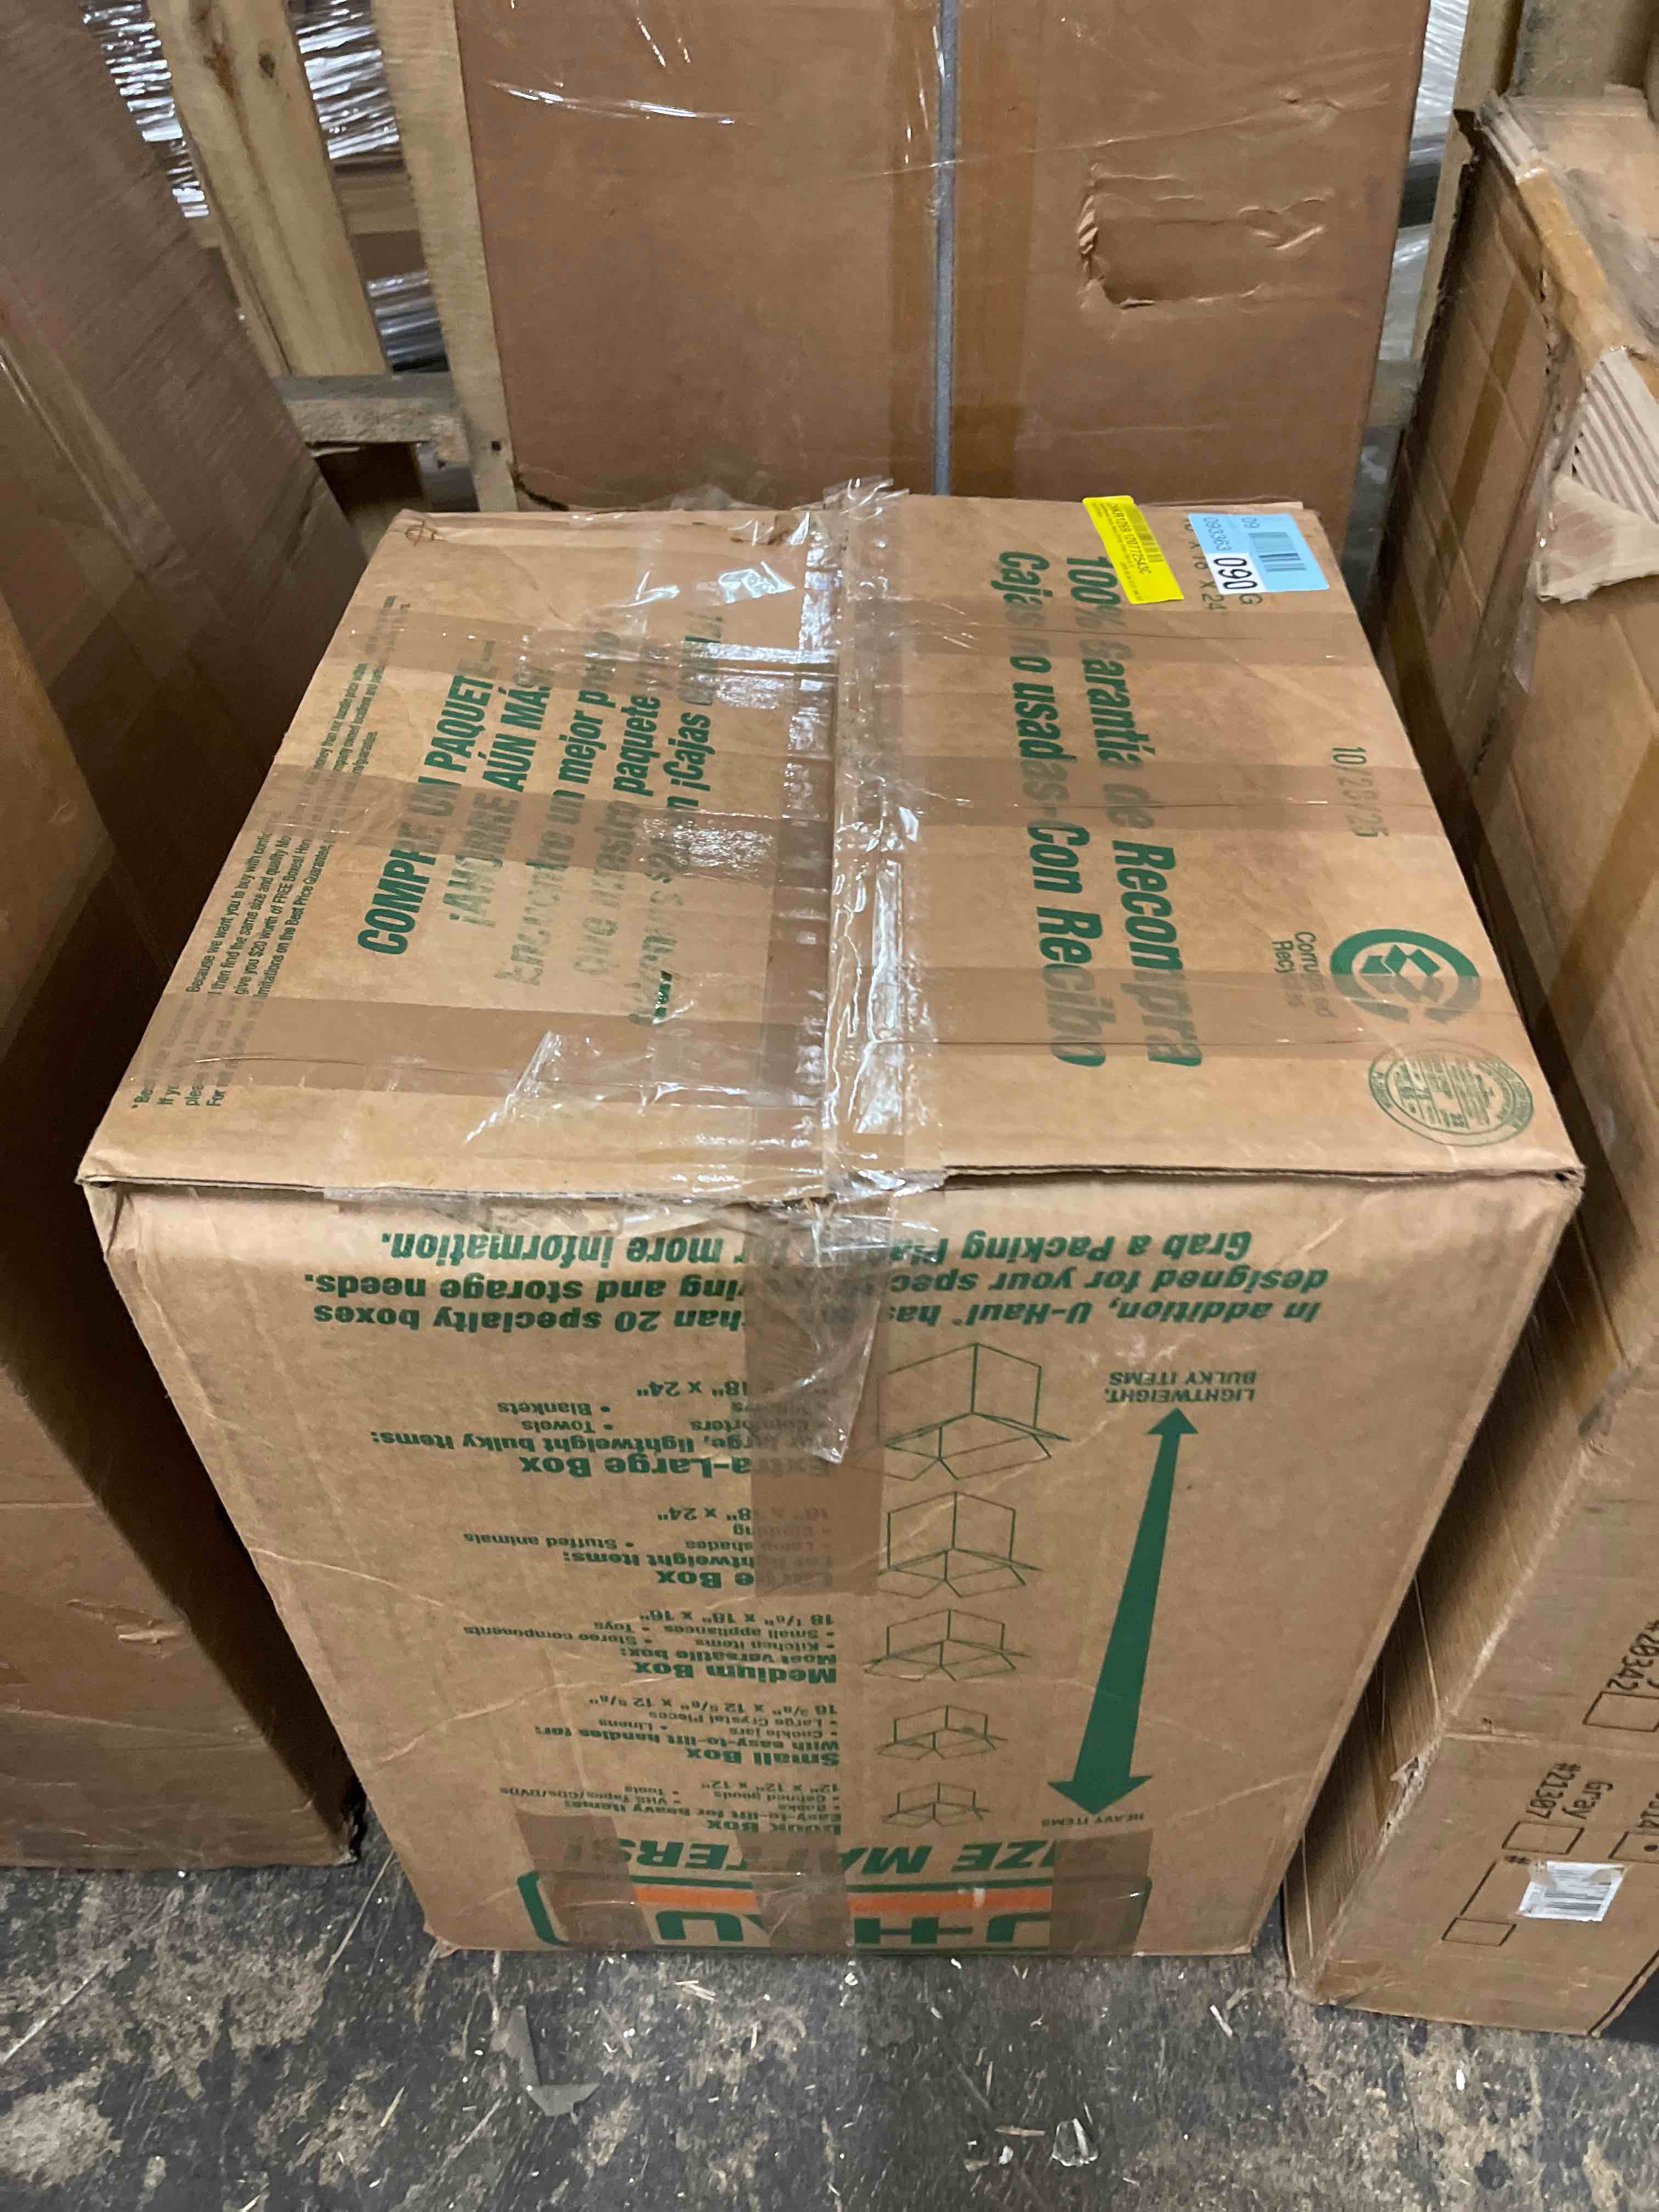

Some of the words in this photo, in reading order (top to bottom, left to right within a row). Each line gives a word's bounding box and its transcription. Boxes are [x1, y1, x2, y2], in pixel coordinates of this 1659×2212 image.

[1214, 557, 1257, 589] 090
[1202, 594, 1227, 610] 24
[557, 710, 606, 784] mejor
[613, 694, 661, 797] paquete
[478, 733, 537, 792] AÚN
[547, 790, 585, 826] un
[991, 552, 1053, 624] Cajas
[1036, 906, 1116, 1066] Recibo
[245, 856, 262, 872] with
[266, 849, 288, 875] quality
[357, 820, 447, 954] COMPRE
[403, 776, 461, 816] UN
[236, 873, 255, 889] buy
[257, 877, 273, 892] and
[250, 894, 266, 910] size
[273, 884, 293, 904] FREE
[294, 886, 313, 905] Price
[225, 900, 240, 915] you
[270, 905, 282, 914] of
[239, 911, 258, 935] same
[285, 907, 303, 926] Best
[213, 917, 233, 938] want
[258, 916, 278, 939] worth
[279, 927, 296, 940] the
[207, 941, 222, 953] we
[229, 937, 247, 950] the
[249, 941, 267, 957] $20
[276, 943, 289, 952] on
[217, 952, 239, 968] find
[1112, 840, 1203, 1066] Recompra
[186, 956, 215, 992] Because
[244, 960, 257, 975] you
[210, 970, 230, 989] then
[234, 977, 249, 995] give
[381, 1232, 614, 1269] information.
[628, 1236, 724, 1267] more
[961, 1231, 1114, 1264] Packing
[1130, 1234, 1153, 1259] a
[1167, 1230, 1253, 1264] Grab
[304, 1273, 427, 1299] needs.
[987, 1267, 1075, 1293] your
[1085, 1269, 1142, 1293] for
[1153, 1264, 1329, 1293] designed
[440, 1272, 583, 1304] storage
[596, 1278, 667, 1304] and
[314, 1304, 420, 1330] boxes
[1109, 1296, 1274, 1324] addition,
[1283, 1300, 1322, 1324] In
[434, 1306, 602, 1331] specialty
[616, 1310, 662, 1333] 20
[1109, 1372, 1177, 1385] ITEMS
[1185, 1371, 1256, 1385] BULKY
[636, 1380, 680, 1396] 24"
[686, 1380, 702, 1395] x
[497, 1402, 592, 1415] Blankets
[521, 1419, 593, 1433] Towels
[462, 1433, 534, 1452] bulky
[541, 1435, 695, 1454] lightweight
[518, 1455, 592, 1478] Box
[657, 1507, 697, 1521] 24"
[703, 1507, 716, 1517] x
[463, 1533, 539, 1547] animals
[546, 1537, 617, 1549] Stuffed
[655, 1570, 723, 1588] Box
[463, 1626, 574, 1641] components
[593, 1622, 633, 1633] Toys
[663, 1623, 761, 1637] appliances
[766, 1628, 819, 1639] Small
[578, 1633, 637, 1646] Stereo
[746, 1640, 819, 1652] Kitchen
[619, 1647, 669, 1660] box:
[675, 1649, 774, 1663] versatile
[778, 1652, 837, 1664] Most
[633, 1661, 695, 1679] Box
[706, 1664, 837, 1684] Medium
[598, 1718, 653, 1730] Linens
[709, 1713, 769, 1727] Crystal
[775, 1717, 822, 1728] Large
[578, 1728, 660, 1743] handles
[666, 1734, 784, 1750] easy-to-lift
[787, 1739, 840, 1752] With
[685, 1748, 742, 1764] Box
[754, 1751, 840, 1767] Small
[1561, 1781, 1614, 1820] Gray
[706, 1819, 759, 1833] Box
[1041, 1816, 1088, 1827] ITEMS
[1094, 1812, 1144, 1826] HEAVY
